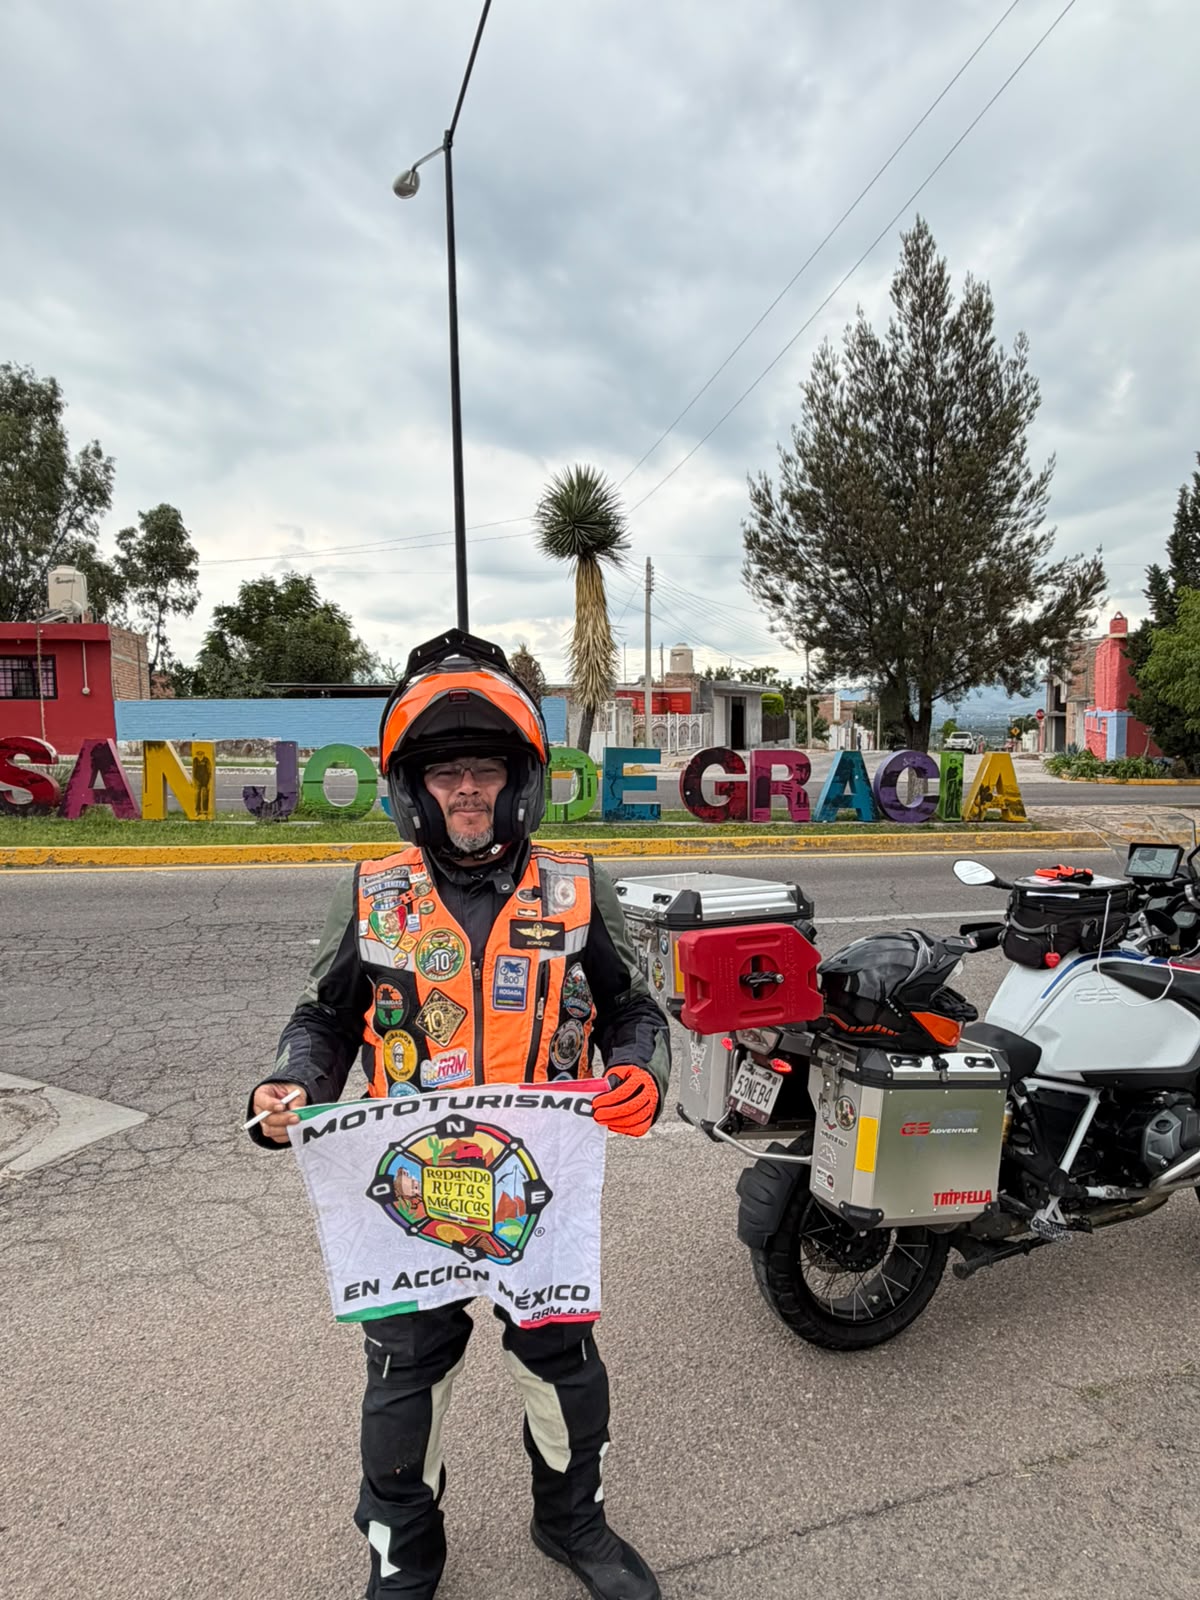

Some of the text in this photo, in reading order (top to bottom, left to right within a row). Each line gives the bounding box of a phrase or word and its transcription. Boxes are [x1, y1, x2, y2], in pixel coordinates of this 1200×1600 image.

[0, 736, 1029, 823] SAN JO DE GRACIA
[434, 951, 450, 972] 10
[503, 976, 519, 984] 800
[424, 1010, 445, 1033] 10
[437, 1052, 467, 1078] RRM
[734, 1074, 773, 1108] 53NEB4
[303, 1094, 593, 1144] MOTOTURISMO
[446, 1120, 465, 1133] N
[900, 1122, 931, 1136] GS
[372, 1183, 390, 1196] O
[531, 1190, 546, 1204] E
[933, 1189, 992, 1206] TRIPFELLA
[344, 1261, 590, 1310] EN ACCIÓN MÉXICO
